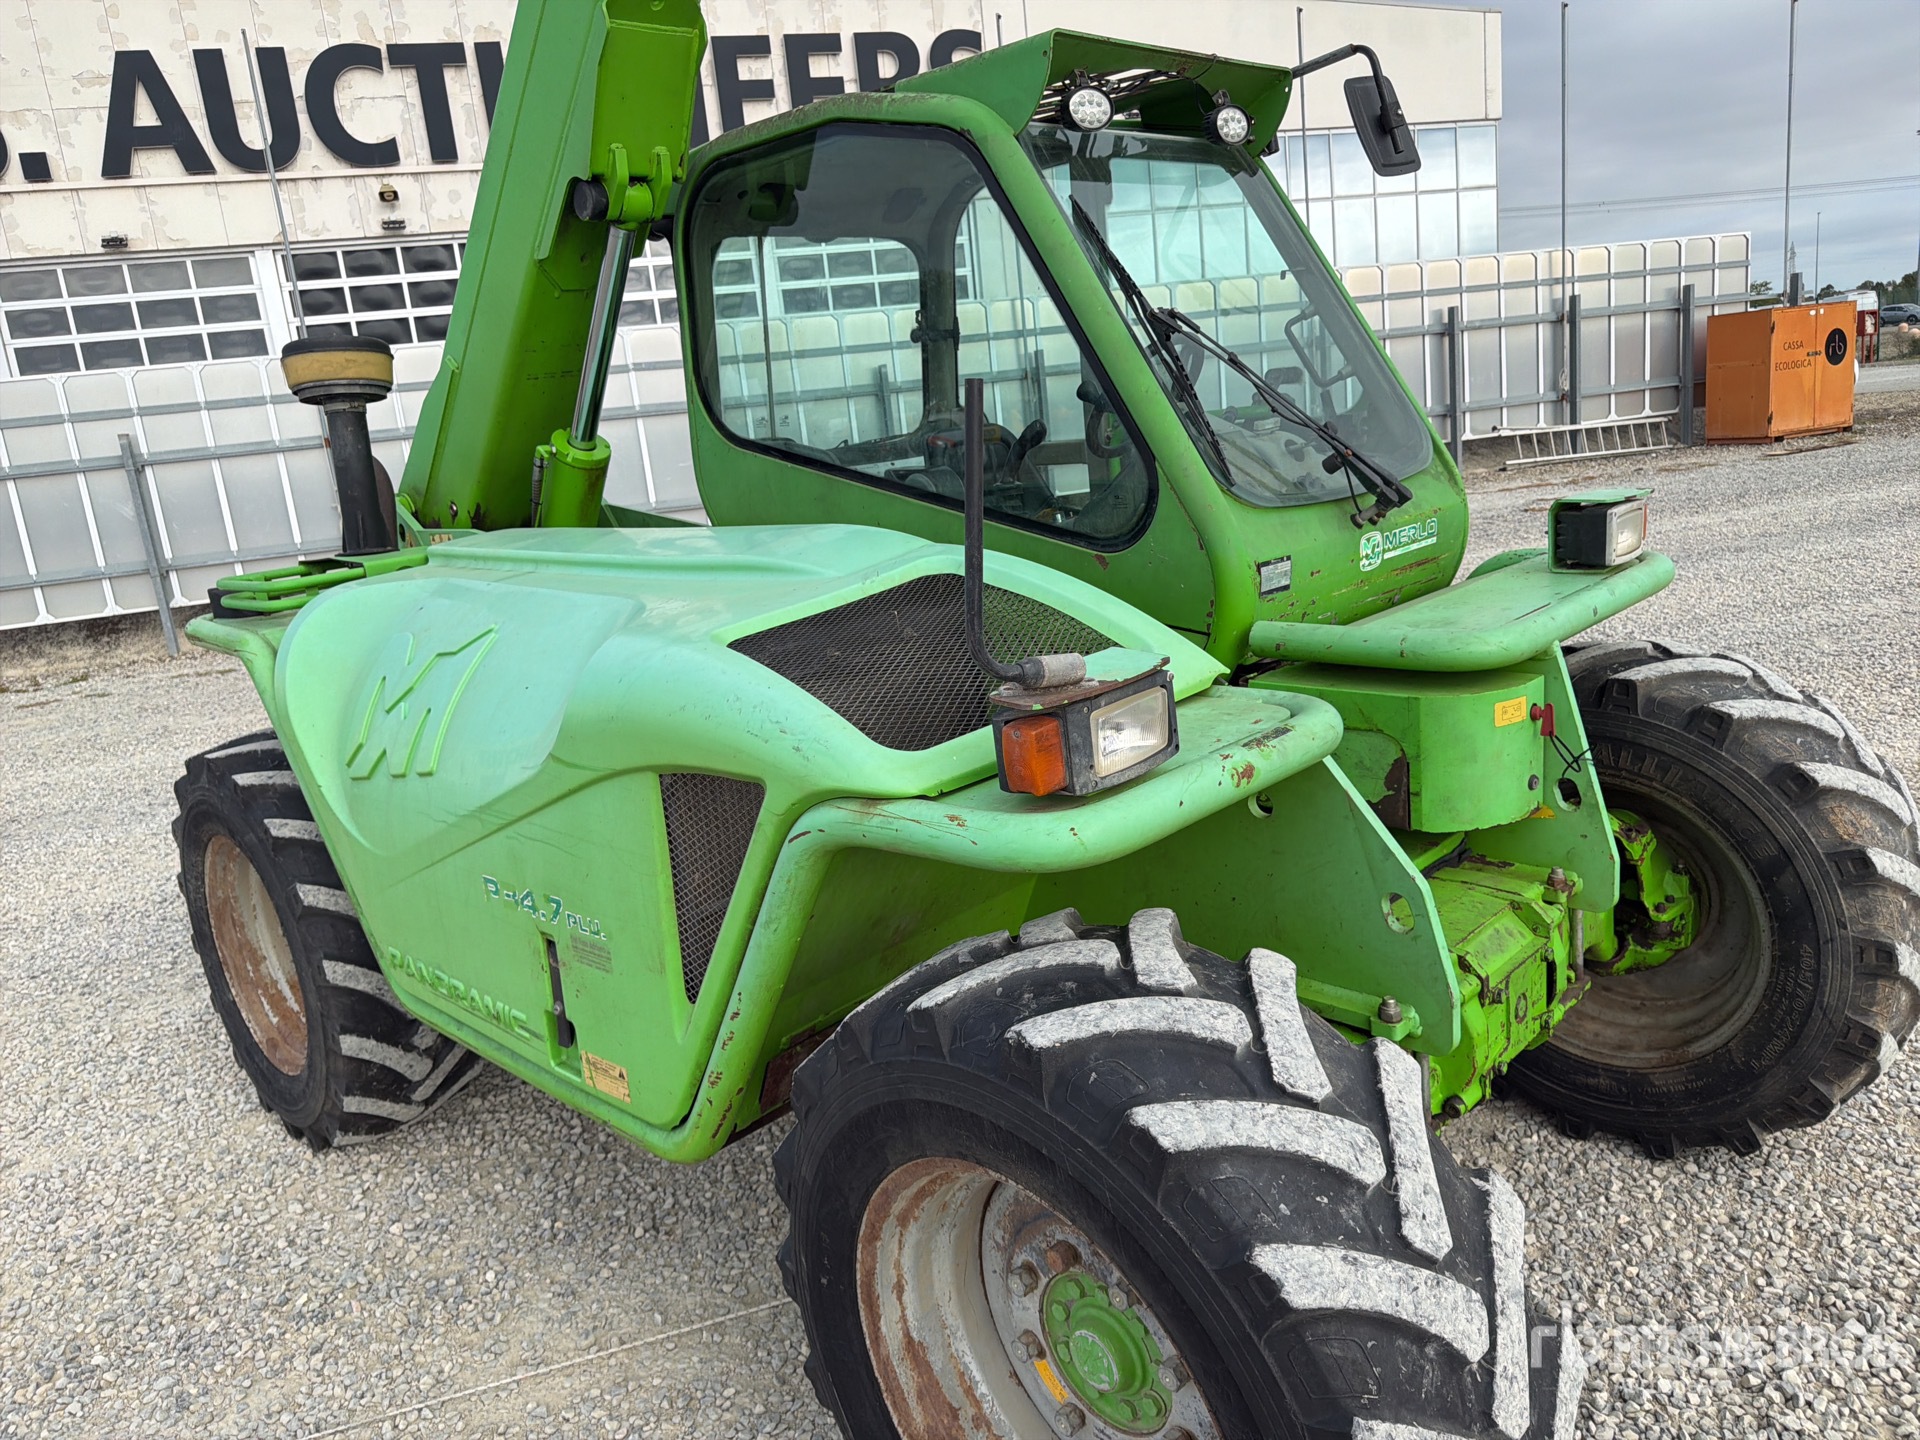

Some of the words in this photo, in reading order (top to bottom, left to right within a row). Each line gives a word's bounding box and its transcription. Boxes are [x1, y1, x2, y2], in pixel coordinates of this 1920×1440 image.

[1783, 340, 1804, 351] CASSA
[1775, 359, 1812, 371] ECOLOGICA
[1383, 518, 1437, 549] MERLO
